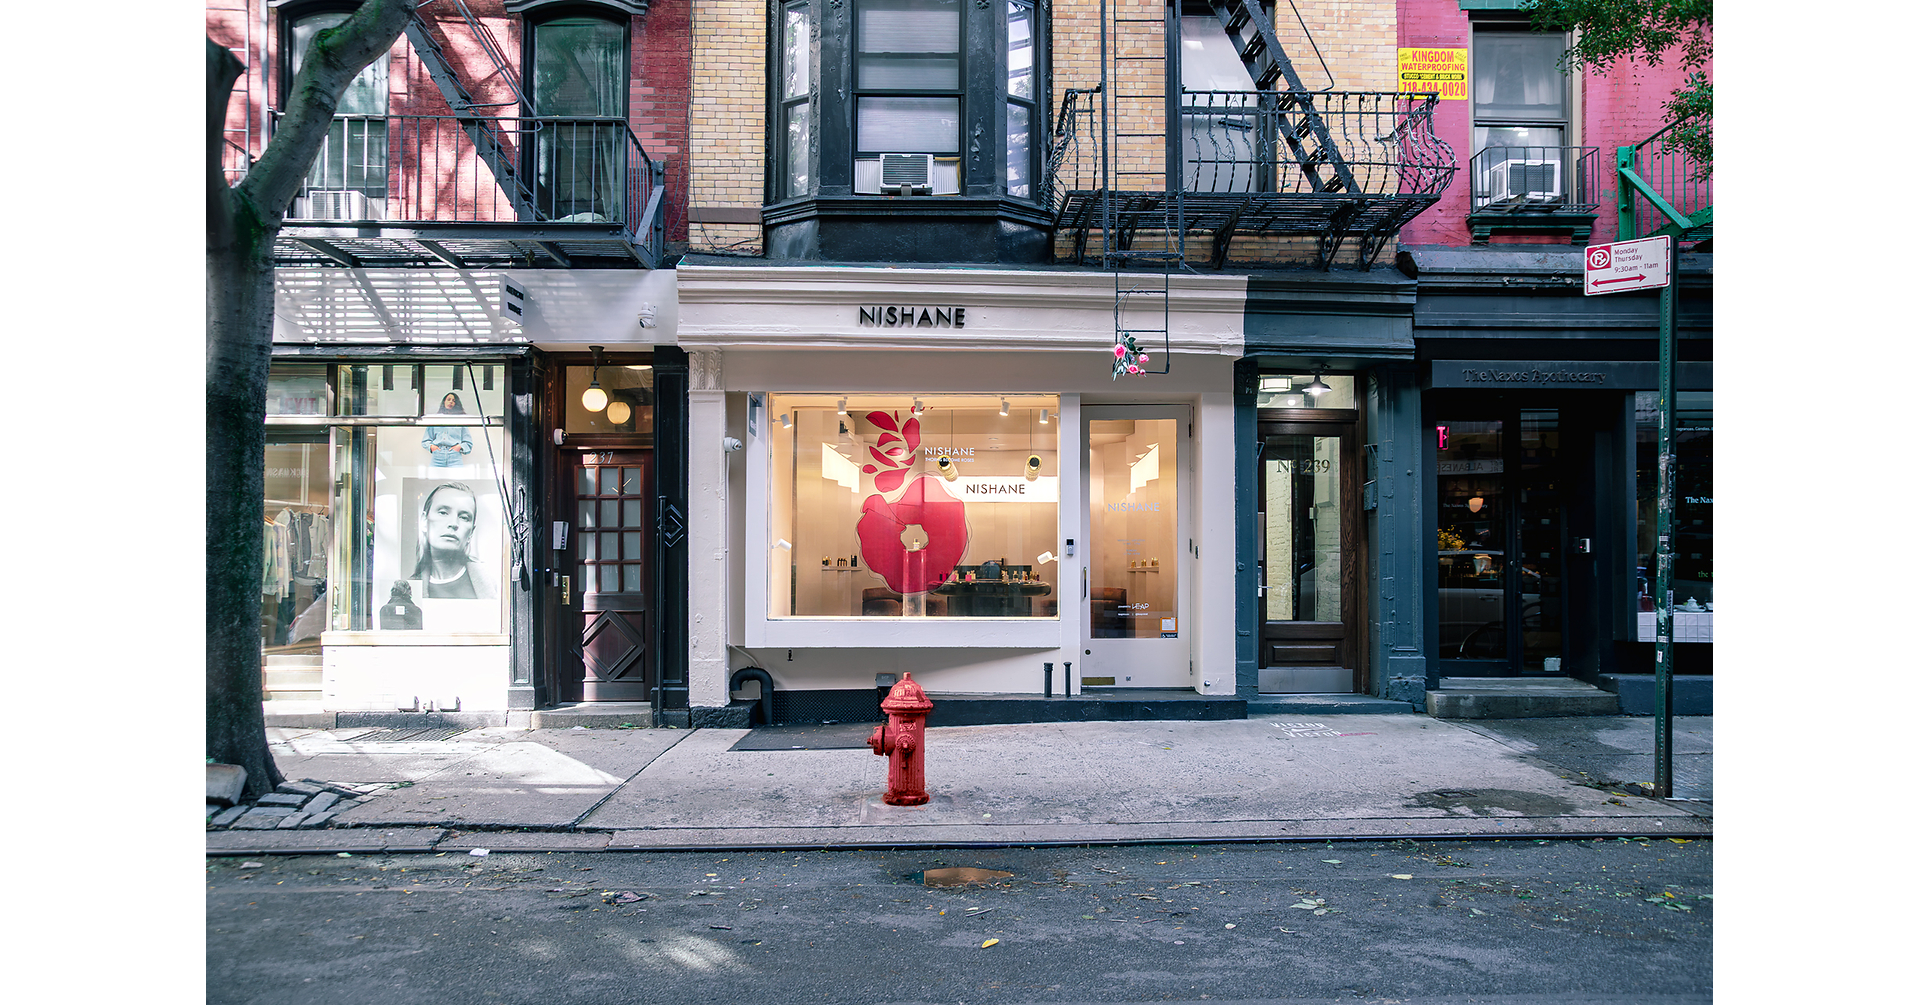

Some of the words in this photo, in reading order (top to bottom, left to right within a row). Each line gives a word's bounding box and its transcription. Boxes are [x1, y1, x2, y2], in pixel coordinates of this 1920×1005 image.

[1412, 50, 1454, 62] KINGDOM
[1401, 62, 1465, 71] WATERPROOFING
[1614, 247, 1638, 256] Monday
[1615, 254, 1643, 263] Thursday
[1614, 265, 1638, 273] 9:30am
[859, 306, 965, 327] NISHANE
[1462, 368, 1488, 382] The
[1489, 368, 1529, 383] Naxos
[1531, 368, 1607, 385] Apothecary
[924, 446, 975, 456] NISHANE
[588, 451, 614, 464] 237
[1303, 459, 1331, 474] 239
[966, 483, 1026, 495] NISHANE
[1684, 496, 1698, 504] The
[1107, 502, 1160, 512] NISHANE
